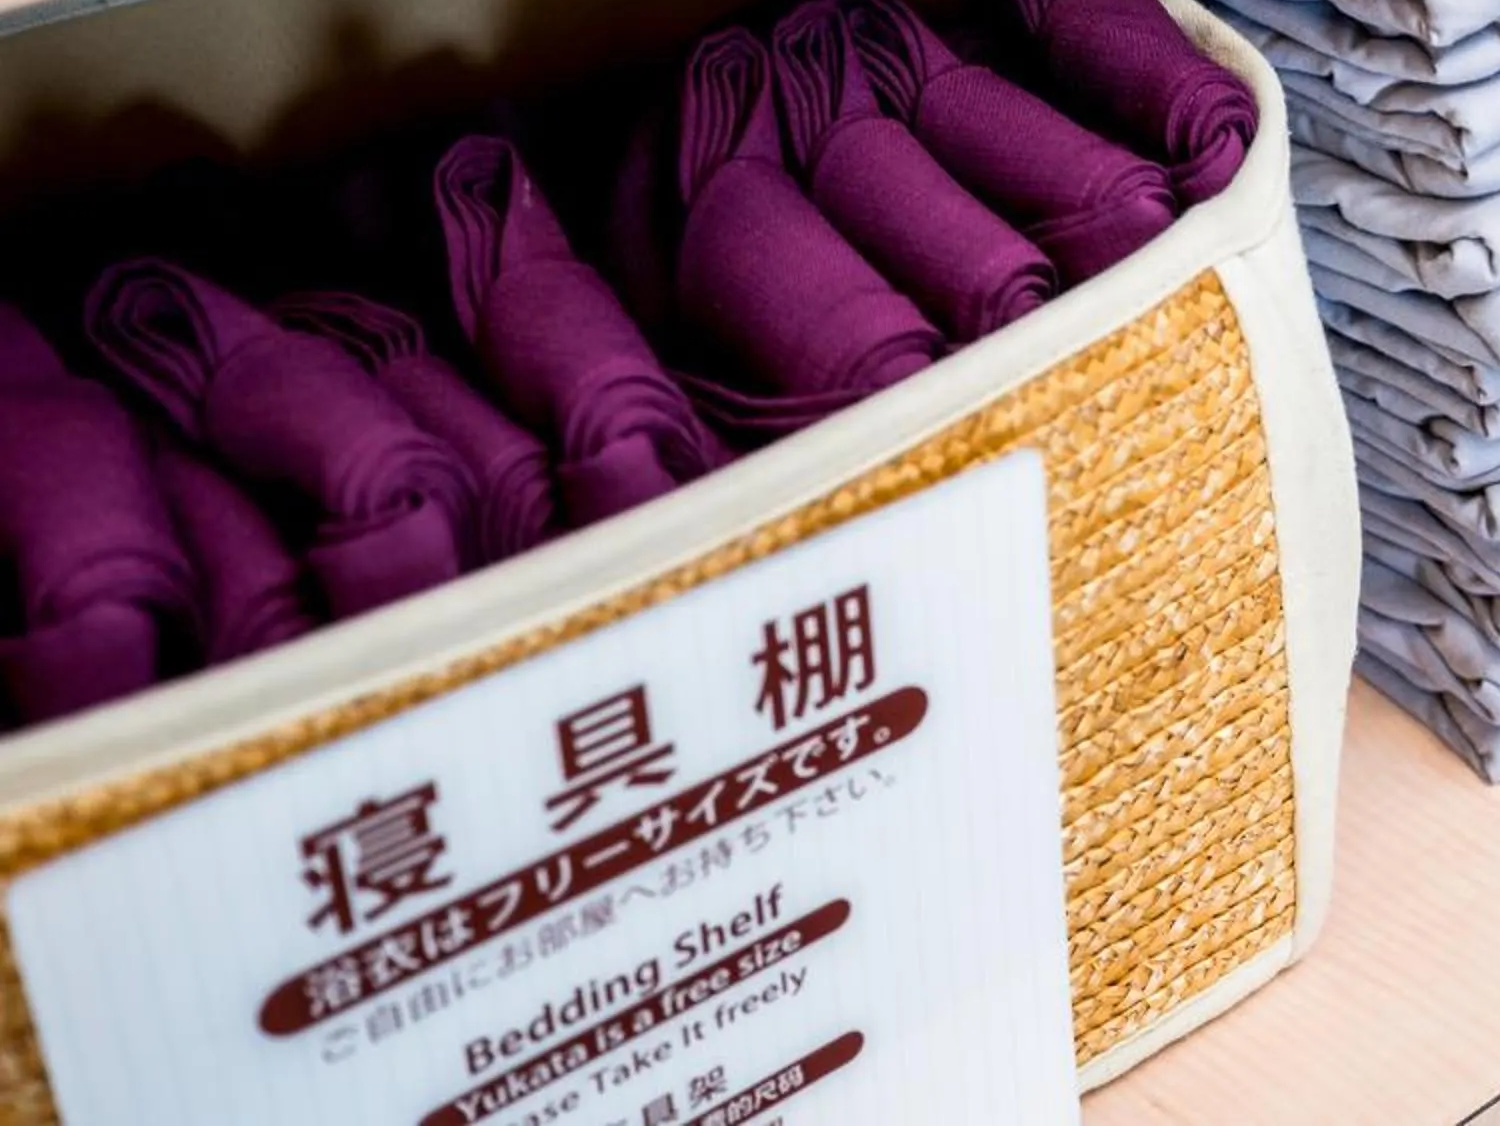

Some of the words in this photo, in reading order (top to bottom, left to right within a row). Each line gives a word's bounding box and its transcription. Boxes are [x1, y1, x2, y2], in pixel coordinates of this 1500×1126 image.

[303, 713, 892, 1019] 浴衣はフリーサイズです。
[455, 1039, 588, 1124] Yukata
[594, 1021, 625, 1052] is
[632, 1008, 654, 1032] a
[659, 969, 730, 1021] free
[738, 929, 803, 973] size
[463, 957, 660, 1075] Bedding
[673, 884, 785, 969] Shelf
[588, 1041, 672, 1094] Take
[714, 965, 808, 1030] freely
